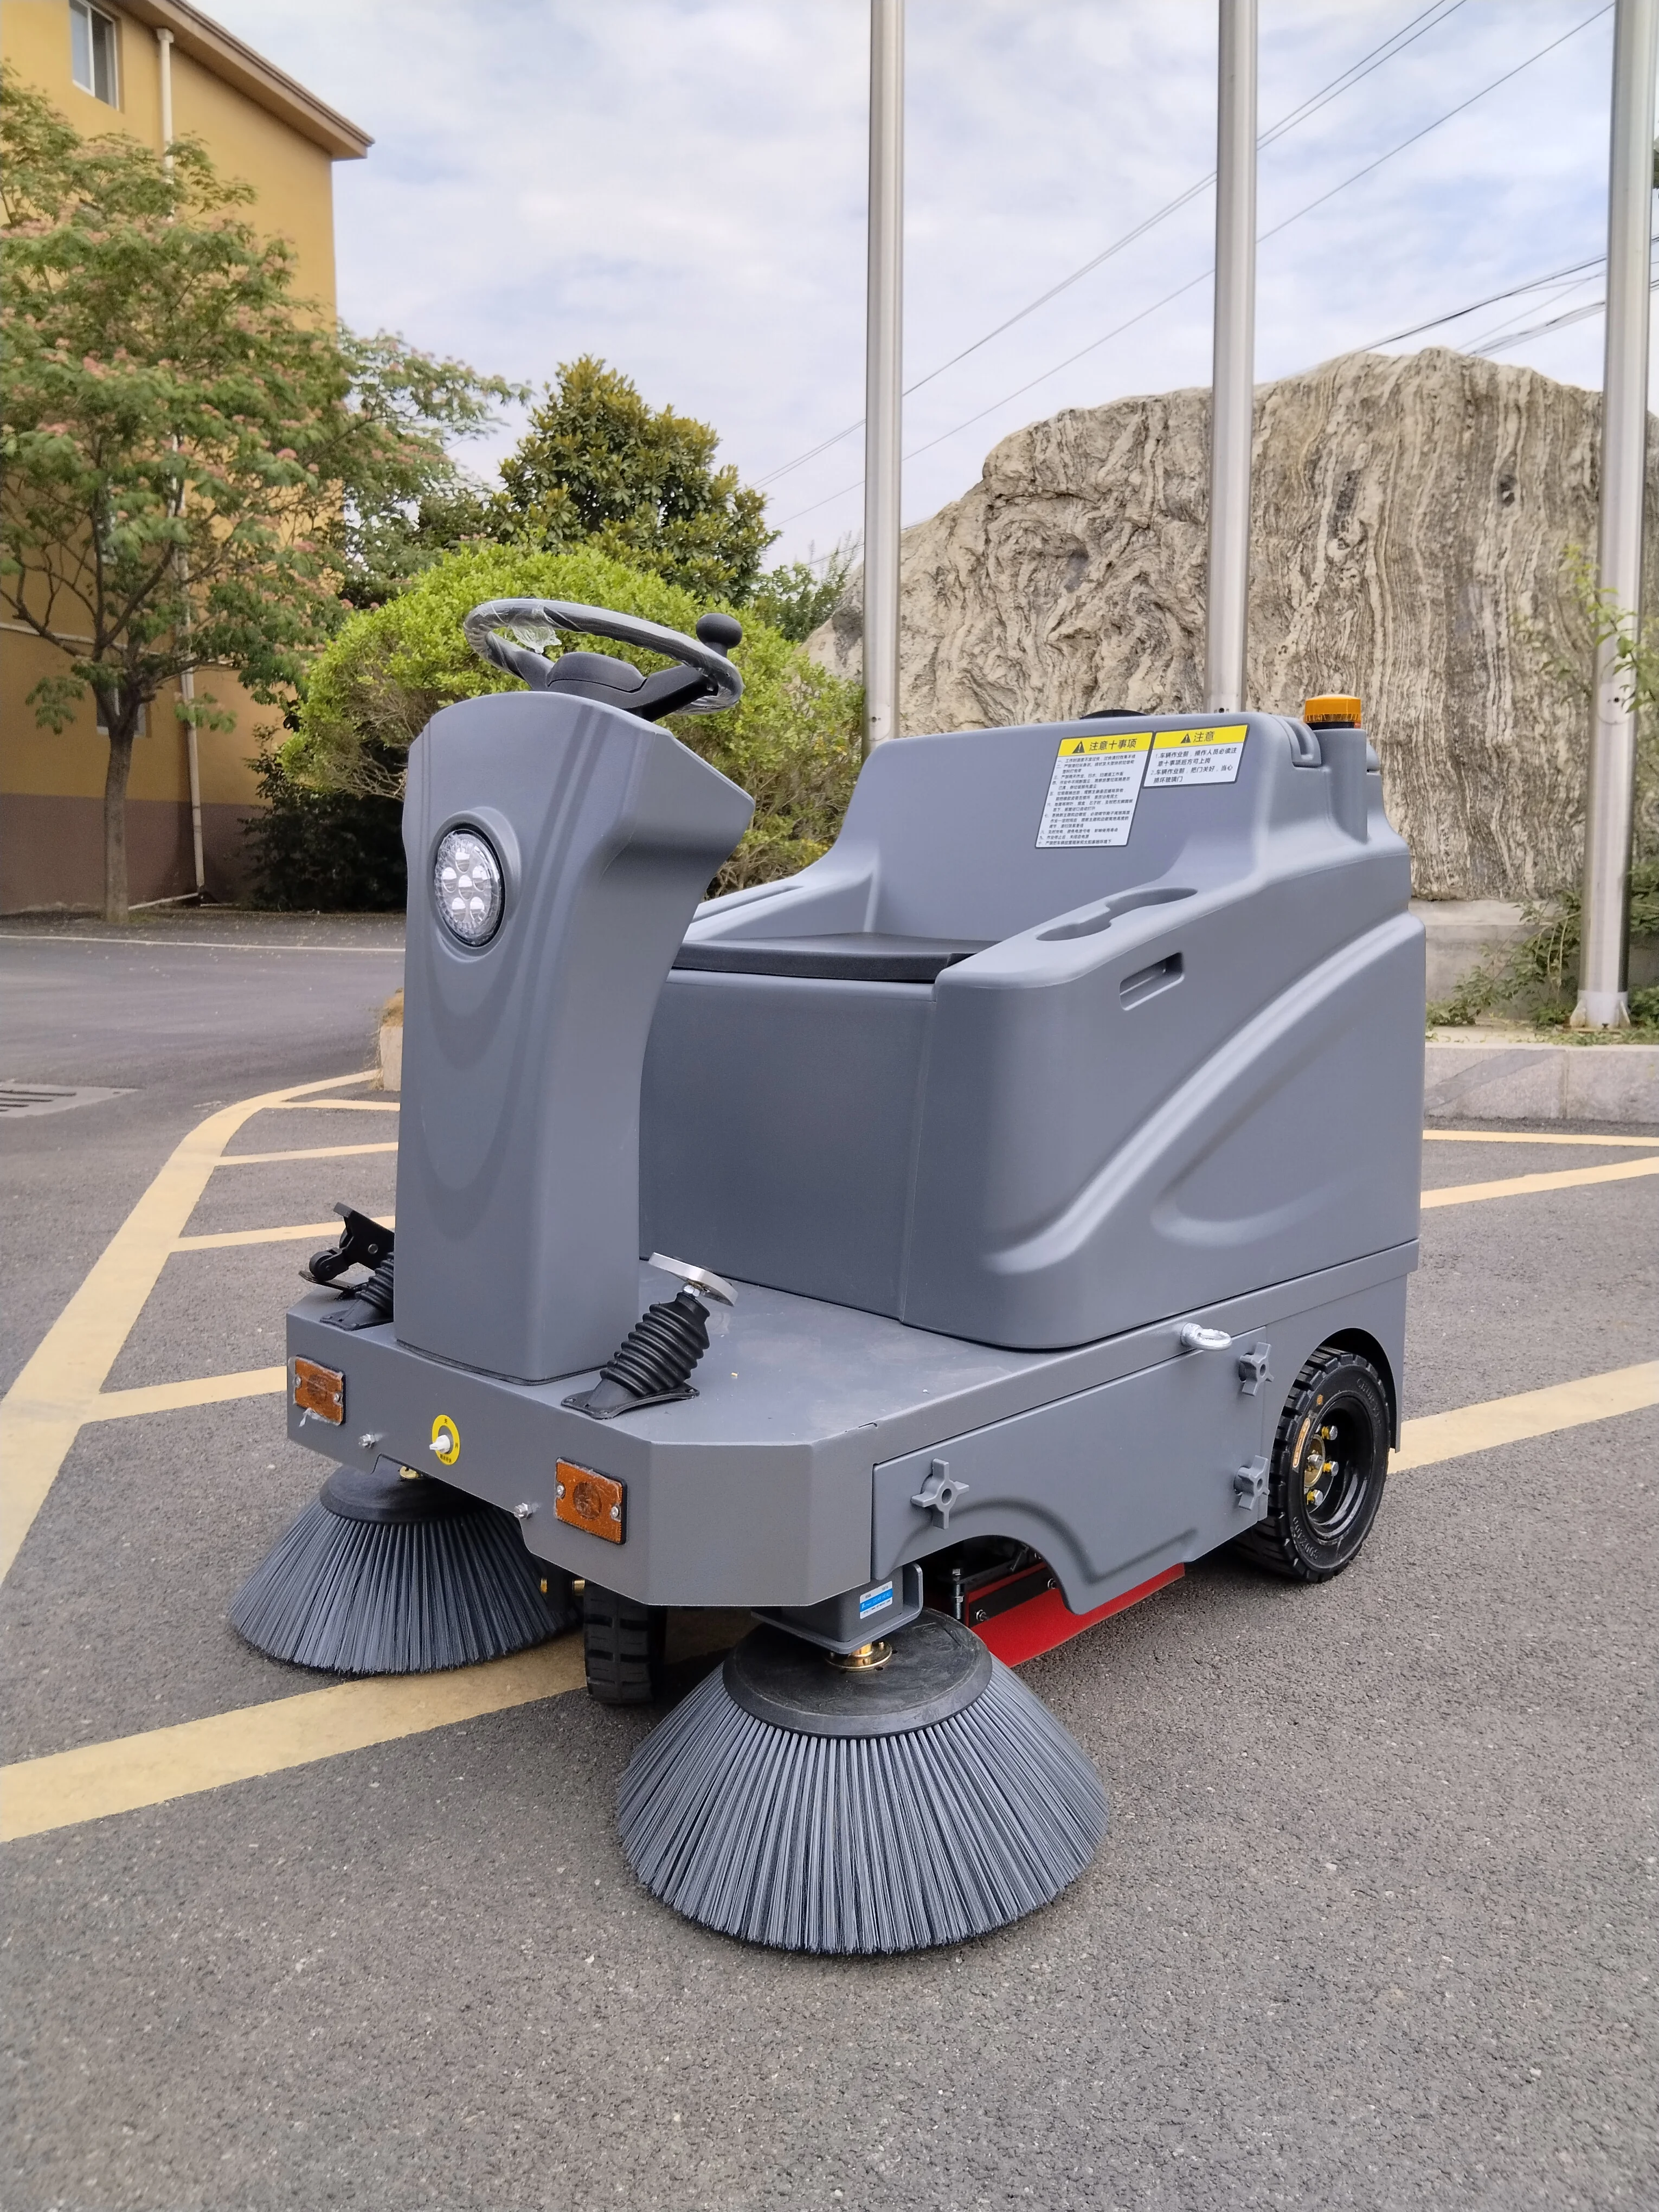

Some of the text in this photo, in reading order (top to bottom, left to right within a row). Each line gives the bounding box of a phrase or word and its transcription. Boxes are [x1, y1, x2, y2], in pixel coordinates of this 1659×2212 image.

[1193, 731, 1215, 743] 注意
[1089, 738, 1137, 751] 注意十事项
